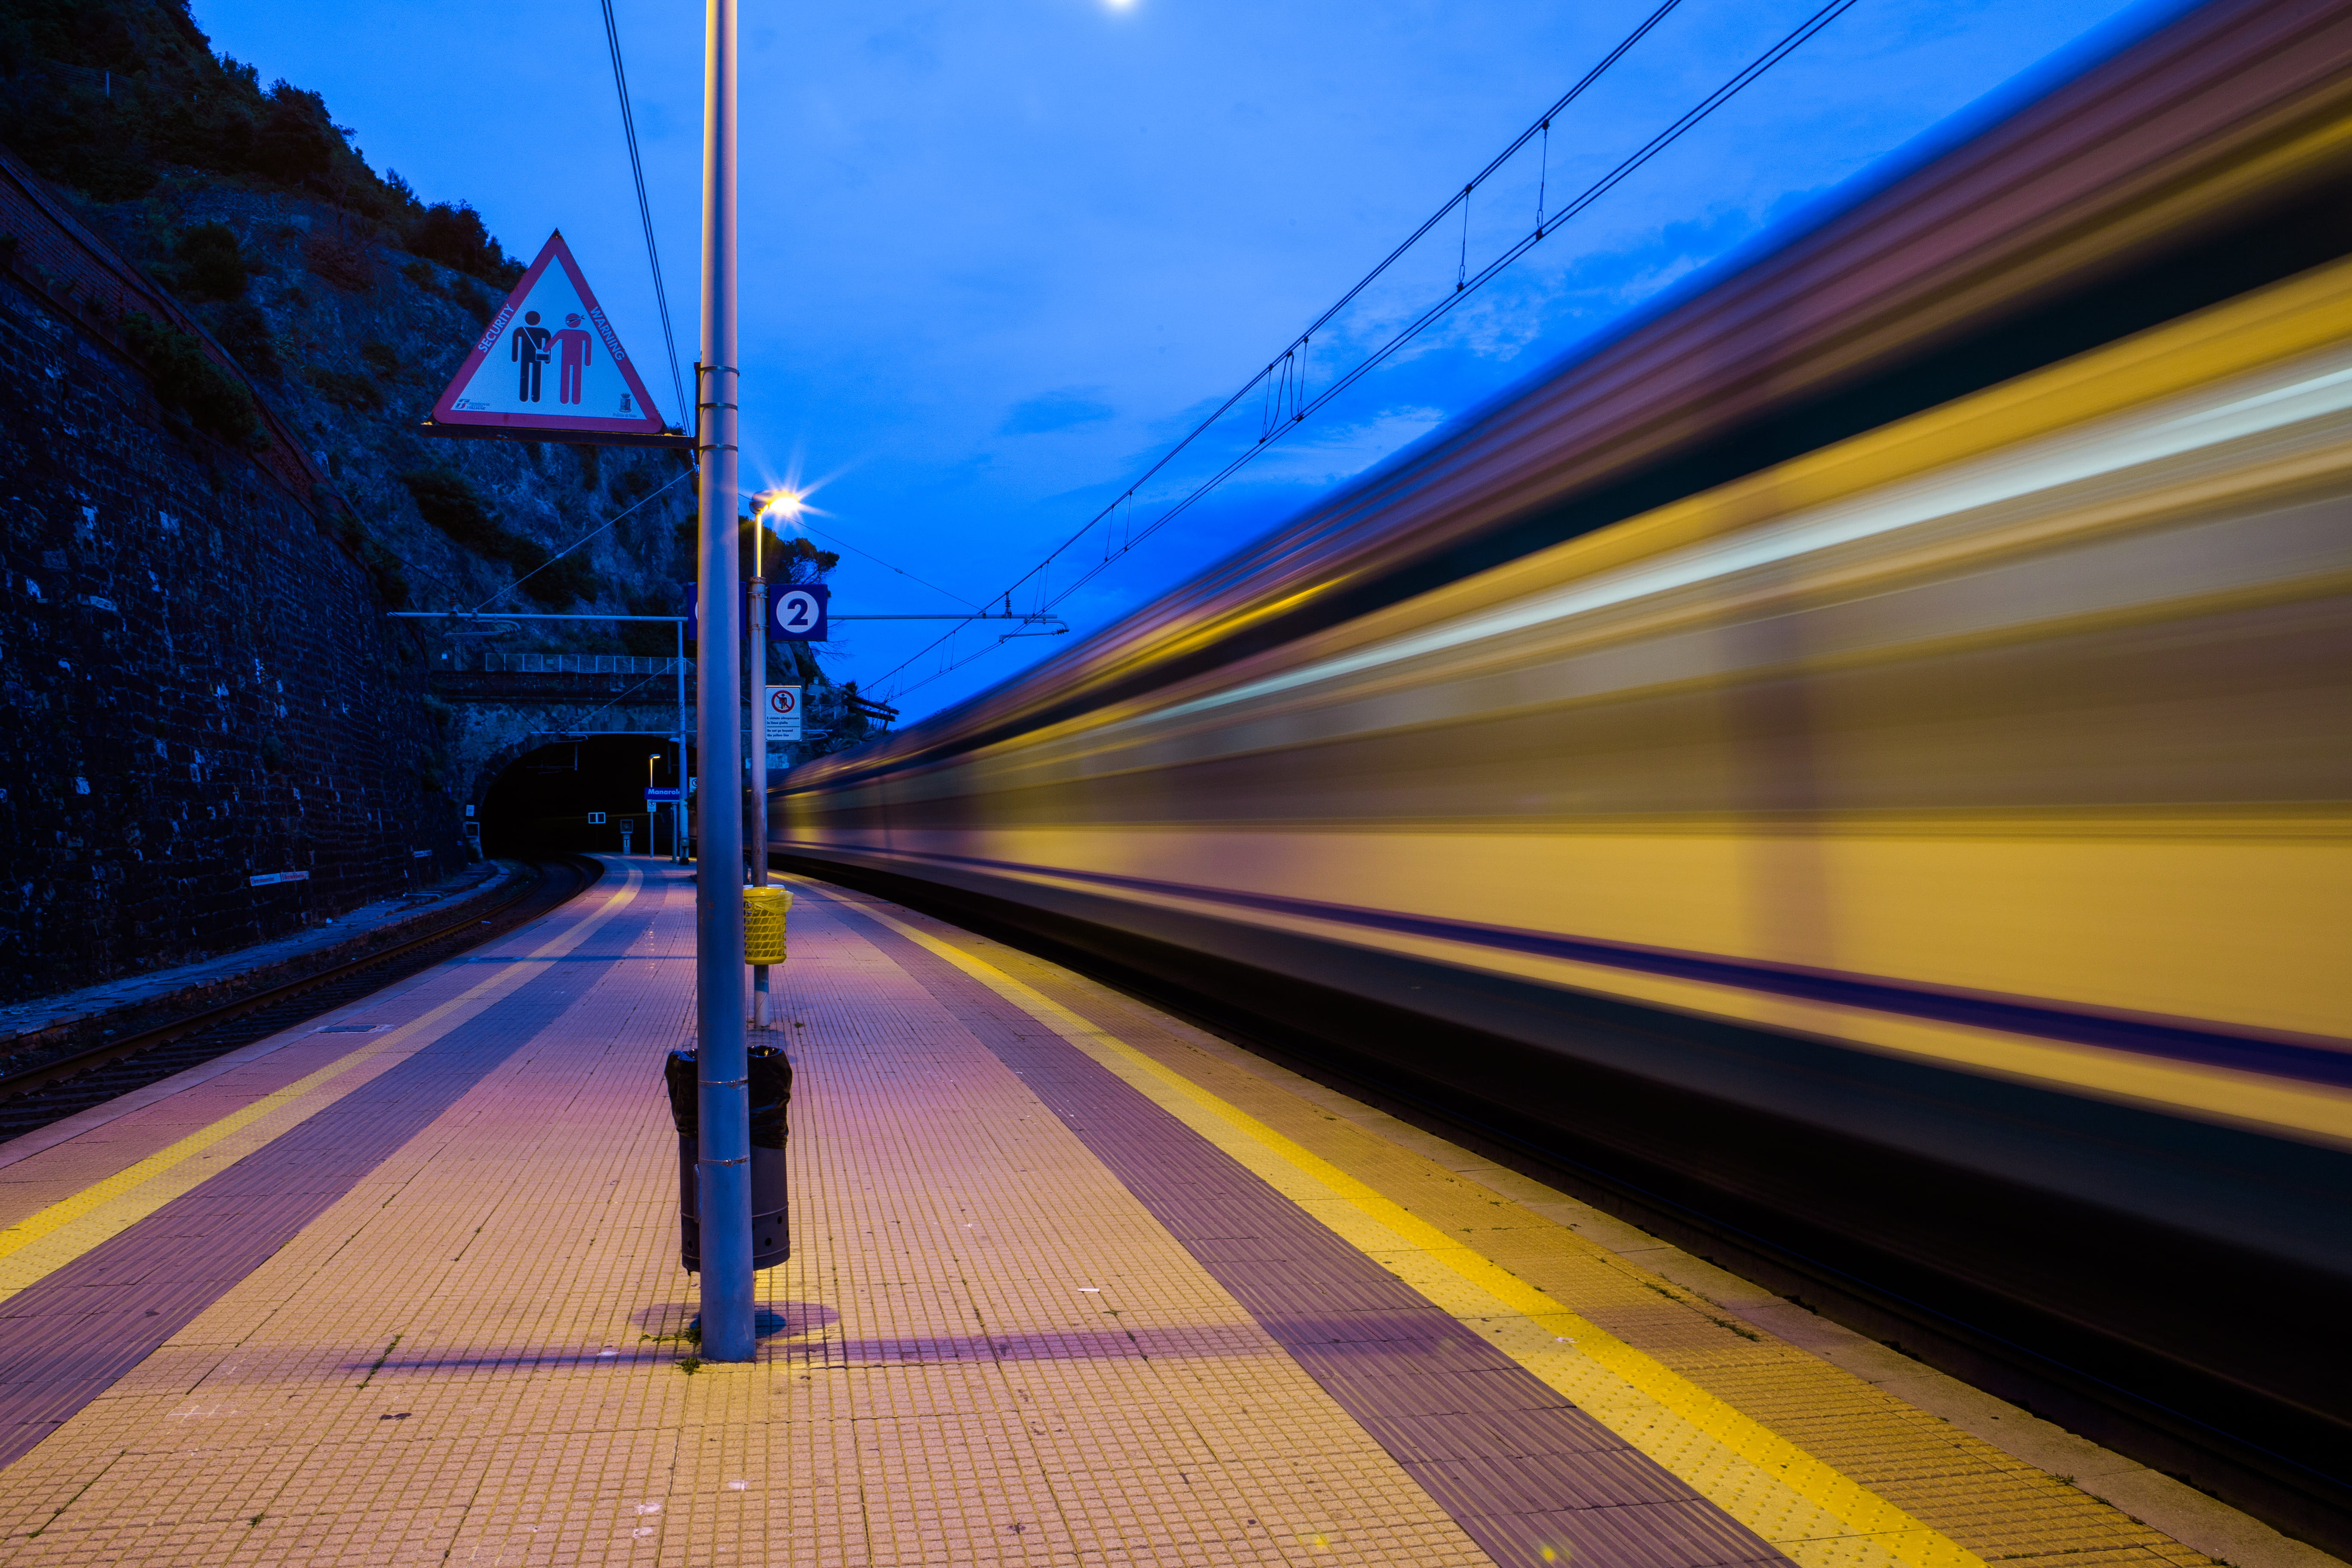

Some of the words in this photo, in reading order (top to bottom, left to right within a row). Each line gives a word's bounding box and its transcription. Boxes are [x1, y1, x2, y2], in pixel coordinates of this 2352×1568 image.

[478, 303, 514, 353] SECURITY
[590, 306, 625, 361] WARNING
[787, 598, 808, 626] 2
